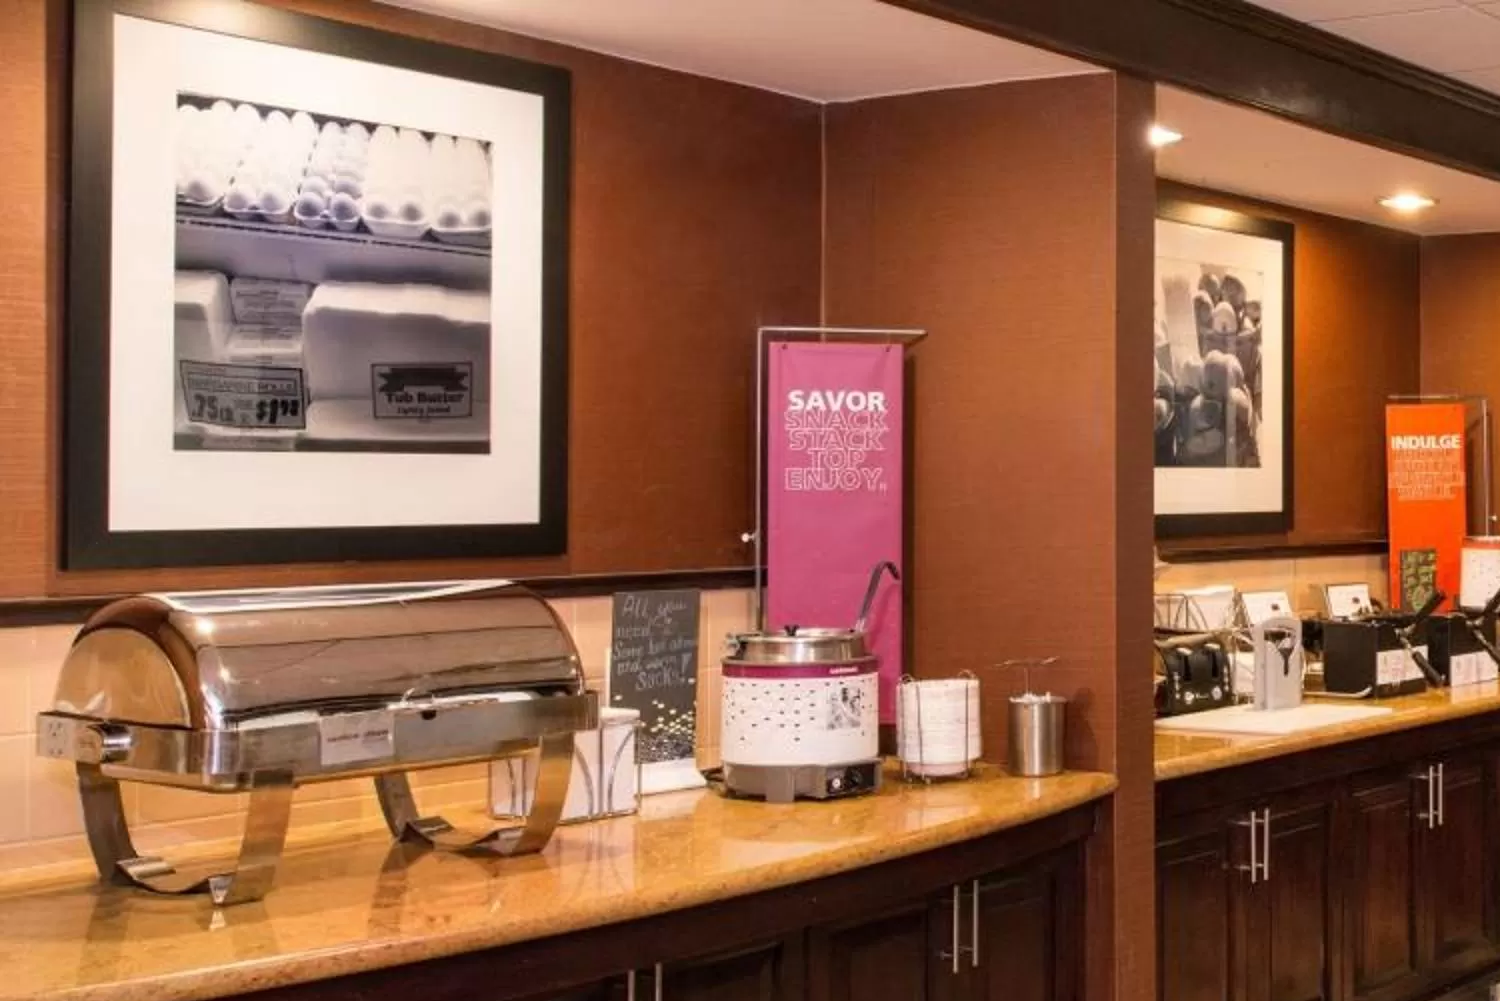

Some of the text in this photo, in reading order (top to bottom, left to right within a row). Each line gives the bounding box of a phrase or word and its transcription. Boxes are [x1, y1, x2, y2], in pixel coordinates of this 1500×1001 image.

[787, 389, 886, 412] SAVOR
[784, 410, 889, 430] SNACK
[788, 428, 887, 450] STACK
[1391, 434, 1461, 449] INDULGE
[807, 448, 866, 470] TOP
[622, 595, 649, 618] All
